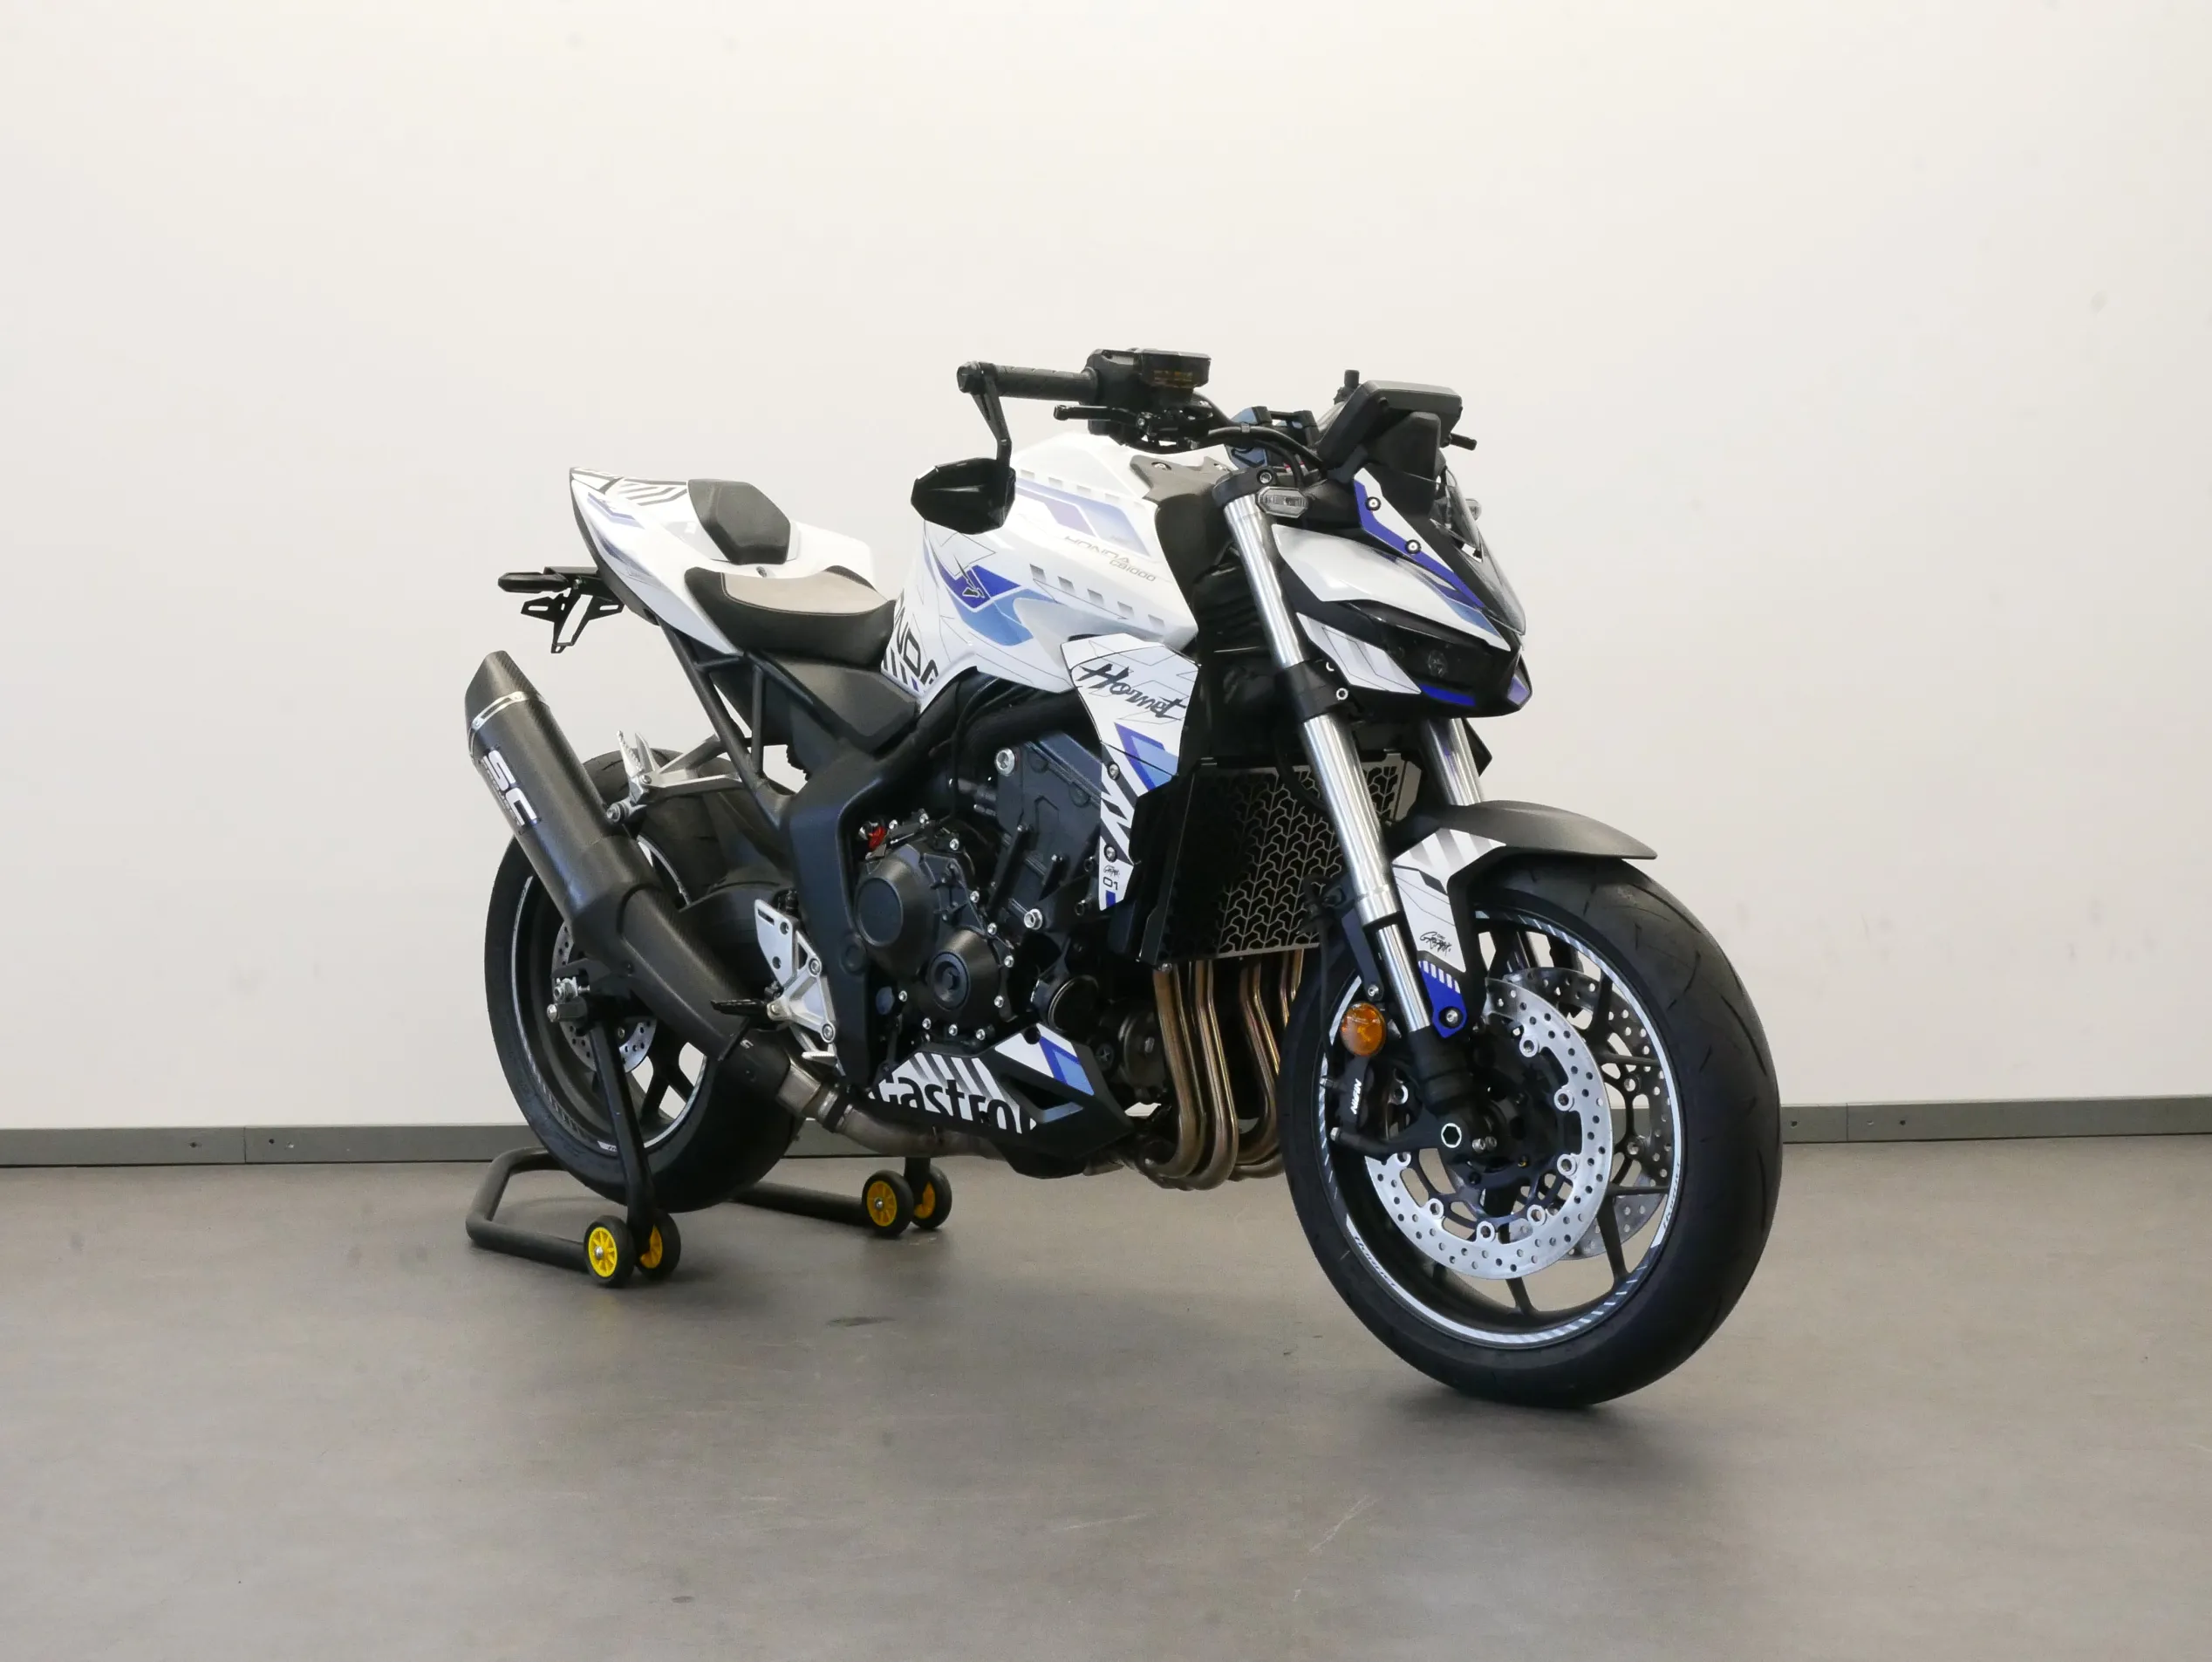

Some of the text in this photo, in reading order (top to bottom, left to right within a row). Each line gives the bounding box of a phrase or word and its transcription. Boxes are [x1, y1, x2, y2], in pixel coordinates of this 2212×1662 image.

[1064, 535, 1130, 564] HONDA
[1075, 662, 1187, 722] Hornet
[482, 749, 537, 826] SC
